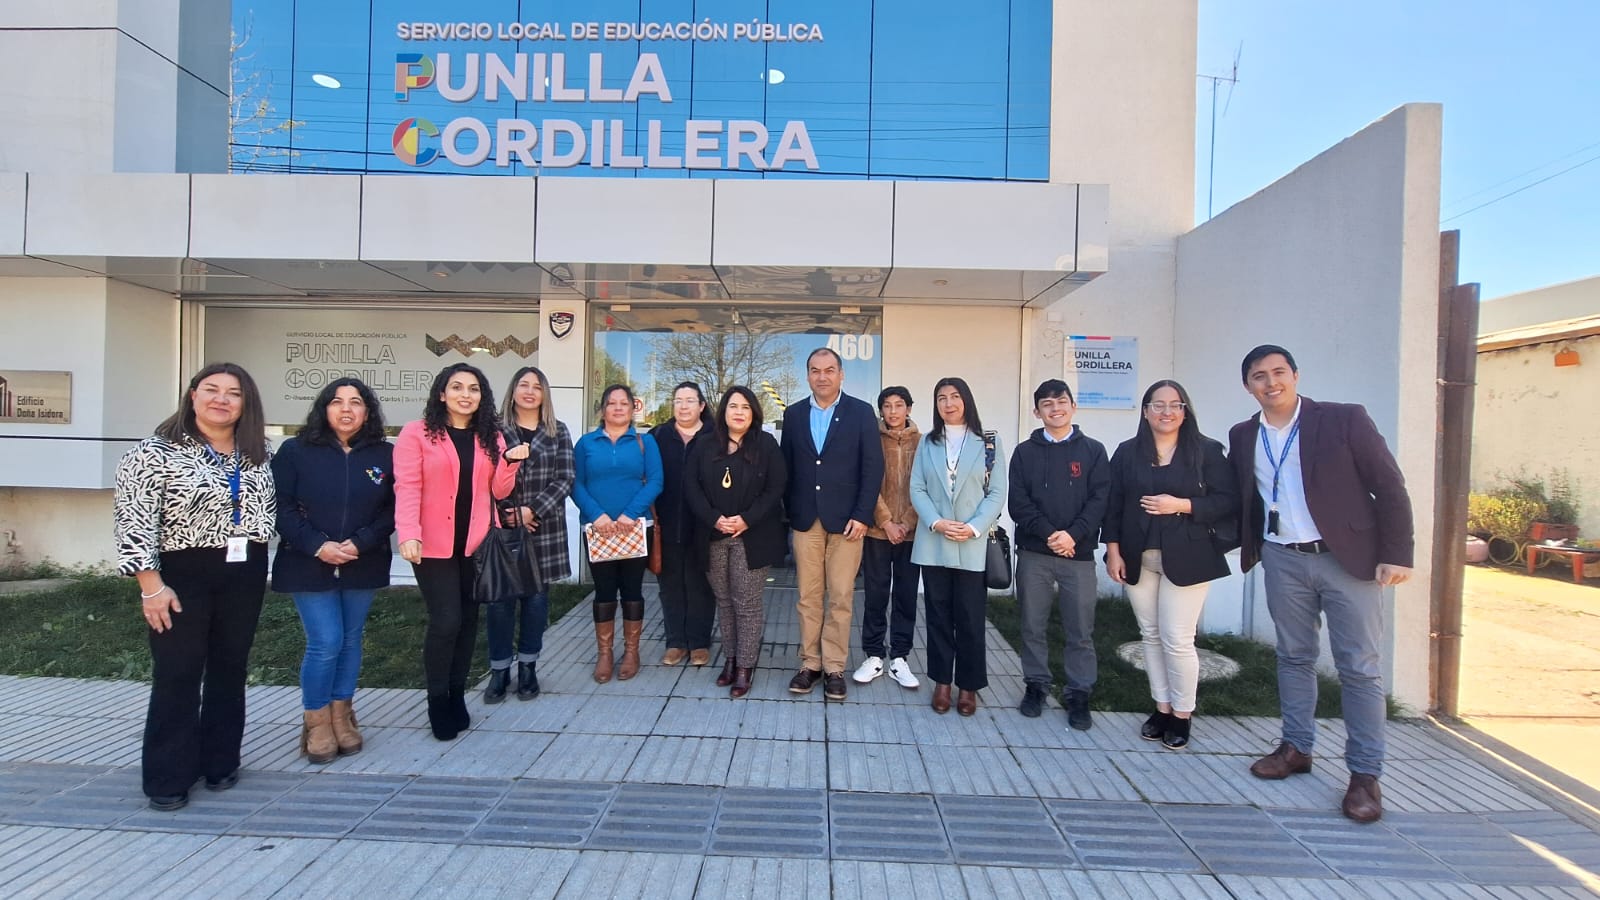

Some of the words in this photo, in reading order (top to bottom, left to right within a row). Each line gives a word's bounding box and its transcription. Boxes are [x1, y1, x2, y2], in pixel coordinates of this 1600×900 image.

[396, 22, 494, 41] SERVICIO
[498, 22, 567, 41] LOCAL
[571, 22, 600, 41] DE
[604, 17, 728, 41] EDUCACIÓN
[733, 18, 824, 42] PÚBLICA
[395, 52, 673, 103] PUNILLA
[392, 117, 820, 171] CORDILLERA
[286, 342, 396, 364] PUNILLA
[826, 334, 874, 361] 460
[17, 396, 44, 406] Edificio
[17, 408, 36, 418] Doña
[38, 408, 64, 418] Isidora
